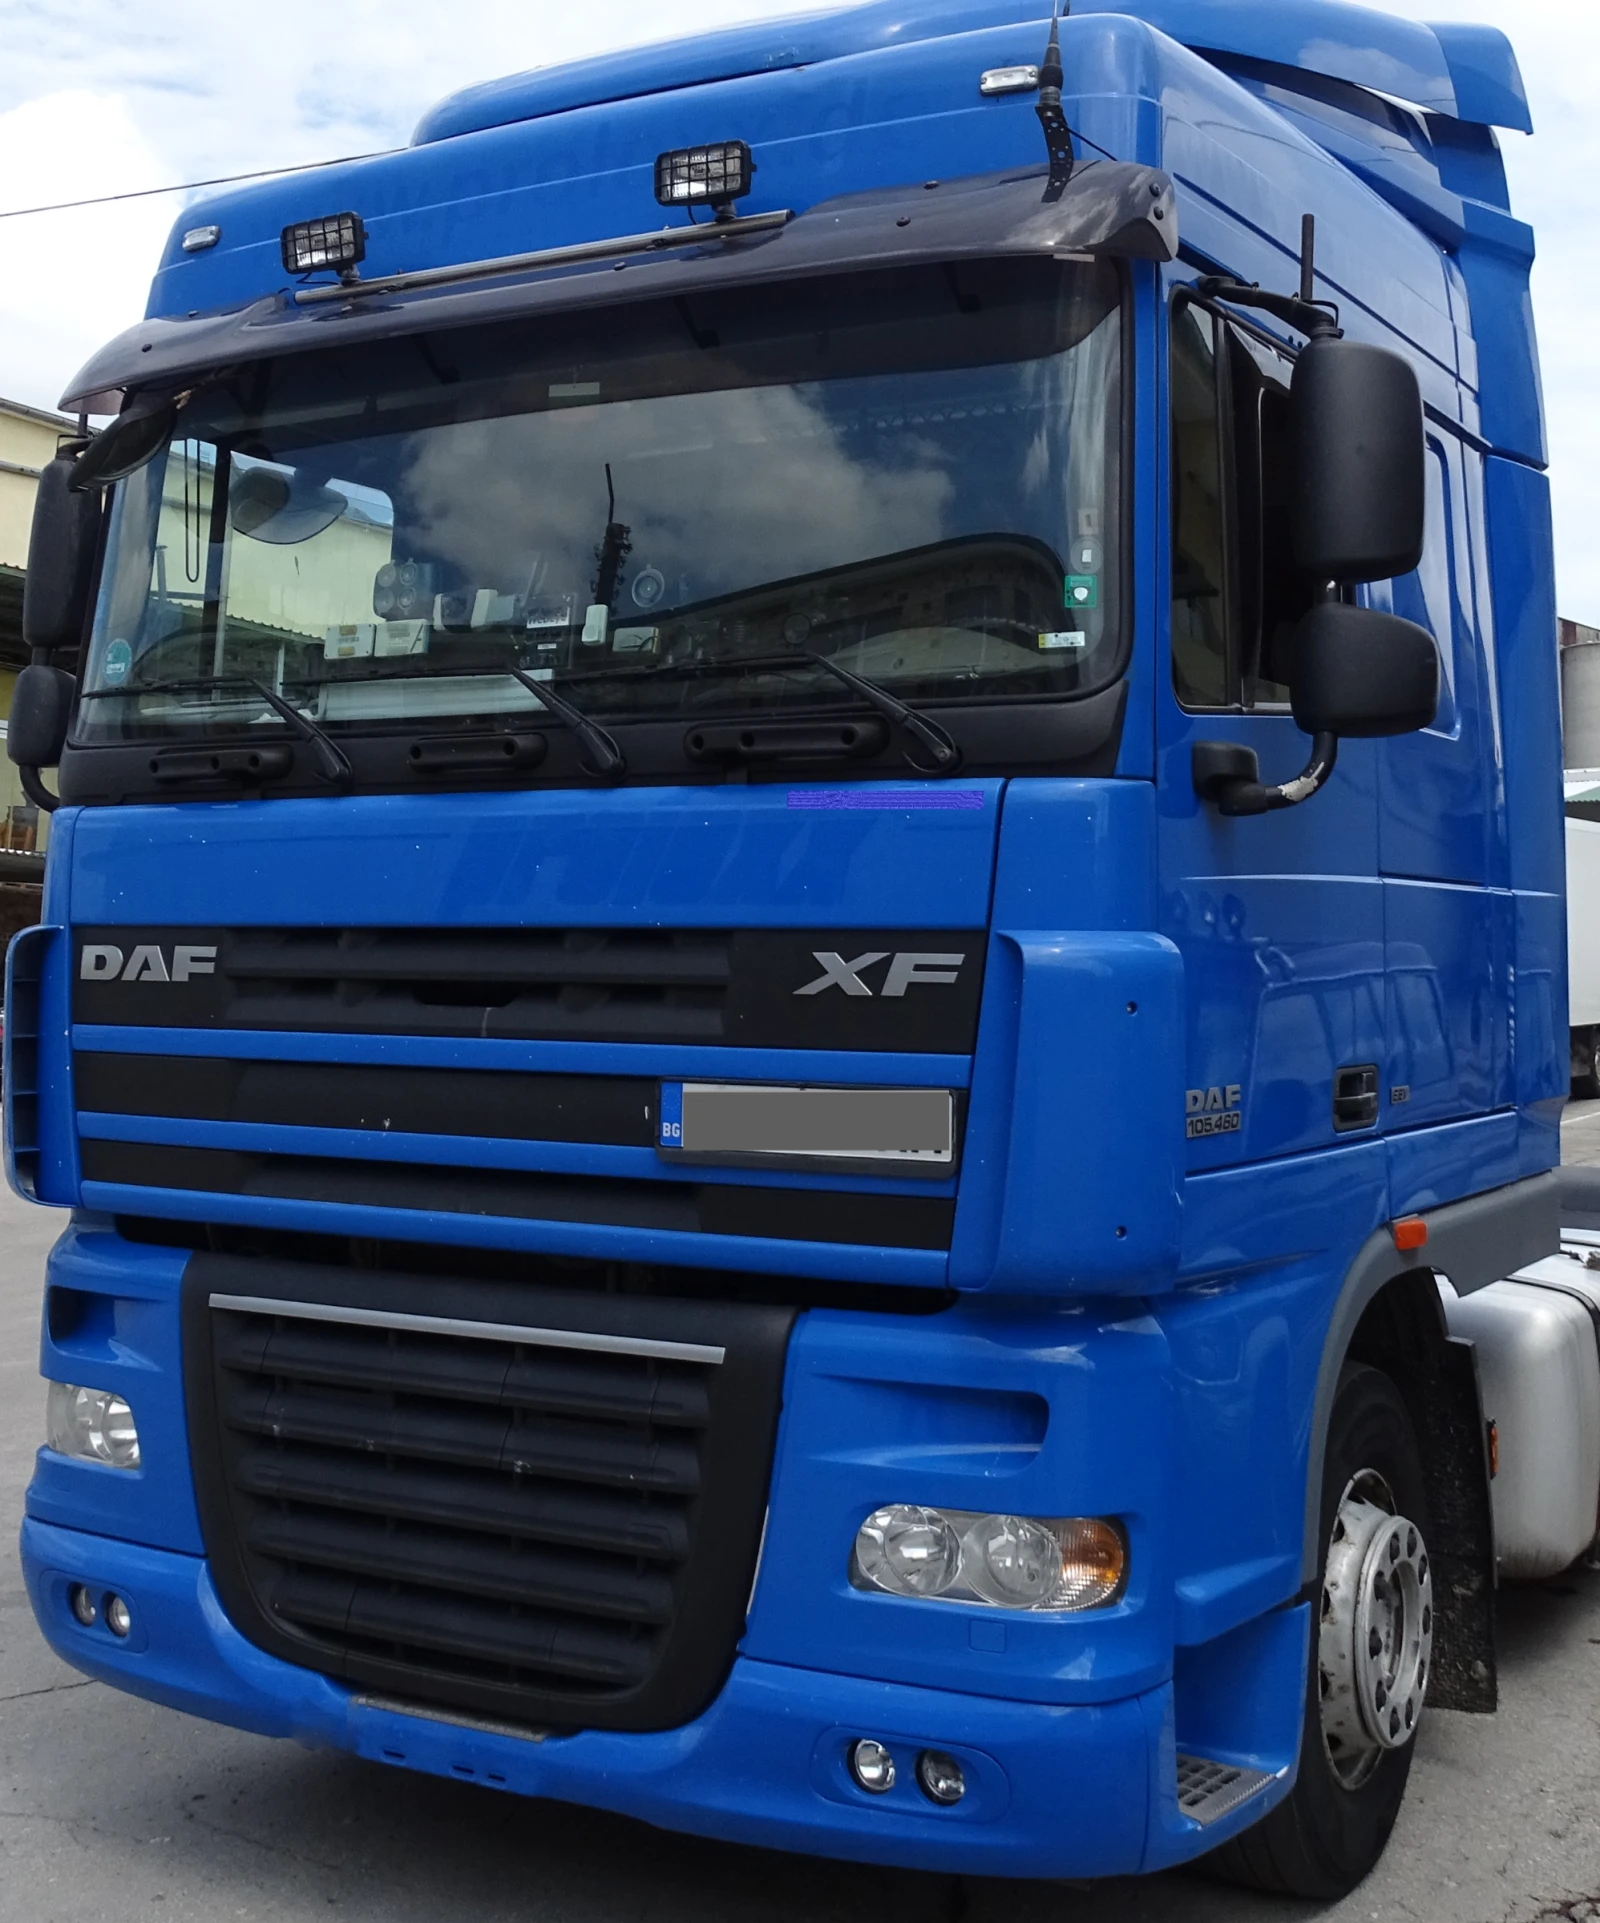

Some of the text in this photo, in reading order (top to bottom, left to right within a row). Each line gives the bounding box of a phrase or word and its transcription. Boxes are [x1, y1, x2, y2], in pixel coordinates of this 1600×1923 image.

[79, 944, 218, 982] DAF
[792, 951, 966, 997] XF
[1186, 1084, 1241, 1112] DAF
[662, 1122, 681, 1138] BG
[1188, 1112, 1240, 1136] 105.460
